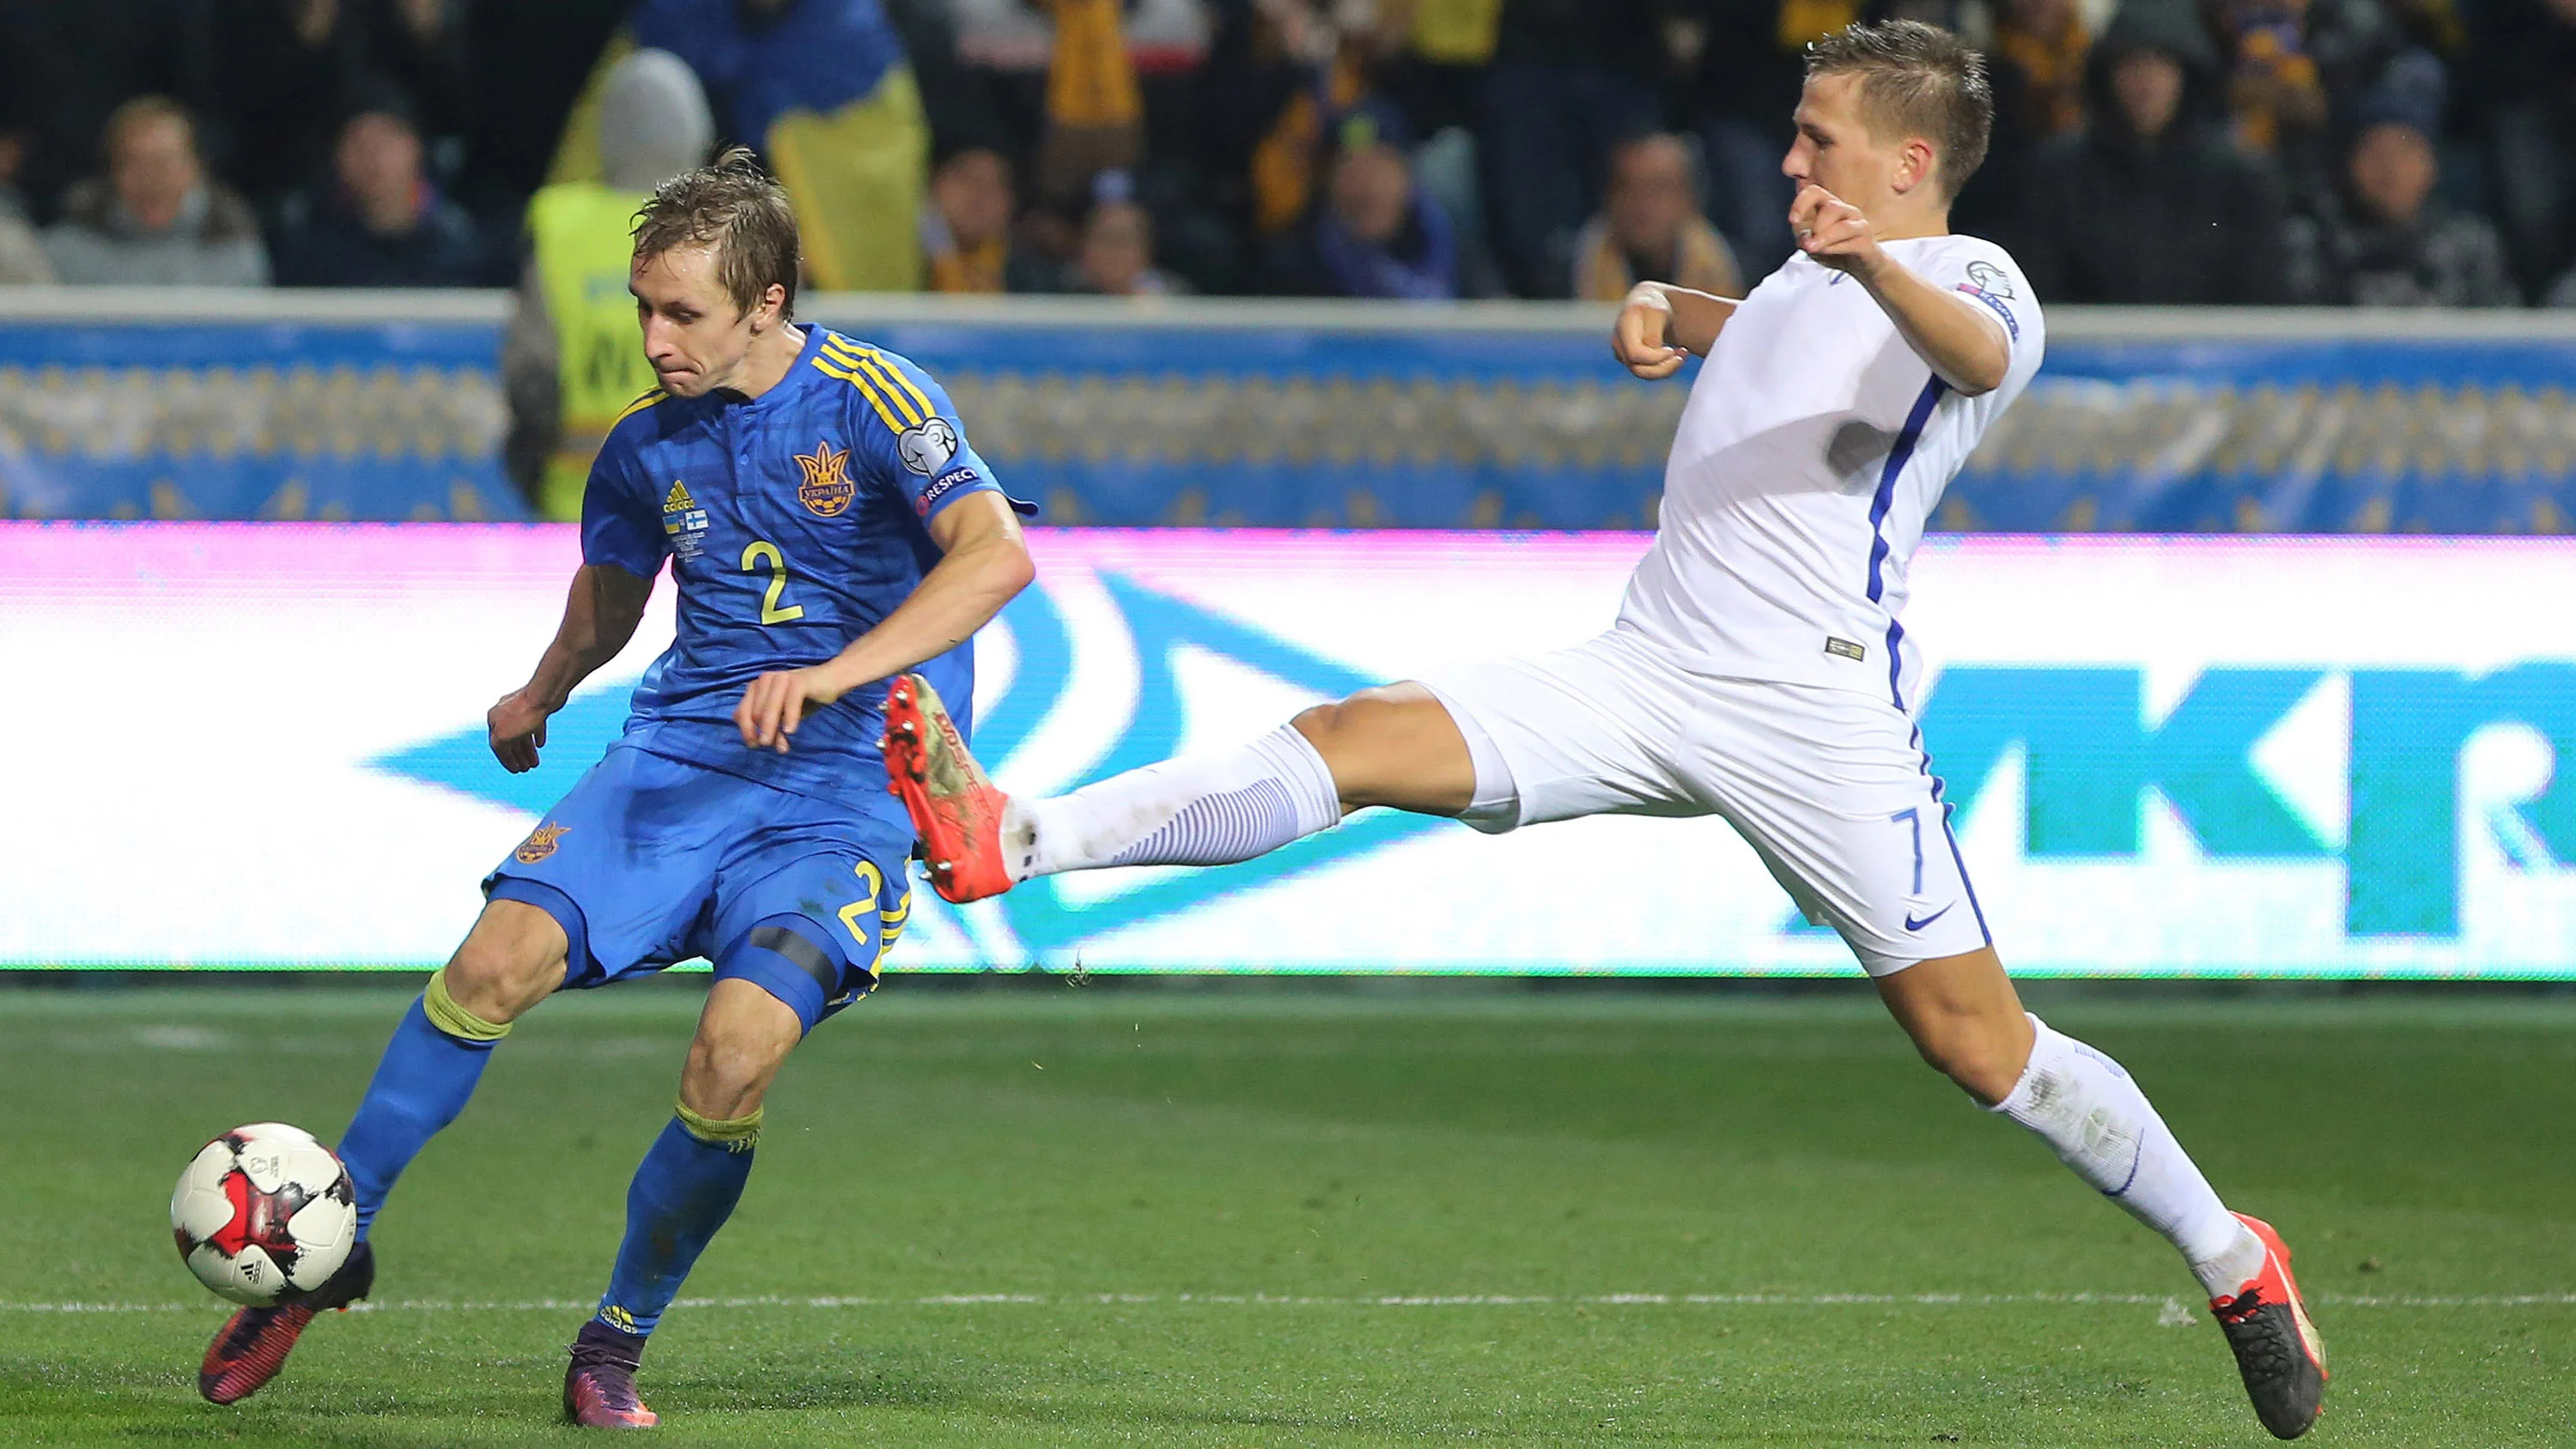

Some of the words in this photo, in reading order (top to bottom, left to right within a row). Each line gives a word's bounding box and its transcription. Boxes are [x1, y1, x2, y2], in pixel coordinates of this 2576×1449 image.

[926, 468, 978, 500] RESPECT
[741, 540, 805, 625] 2
[1890, 807, 1922, 894] 7
[837, 860, 883, 946] 2
[600, 1309, 637, 1334] adidas
